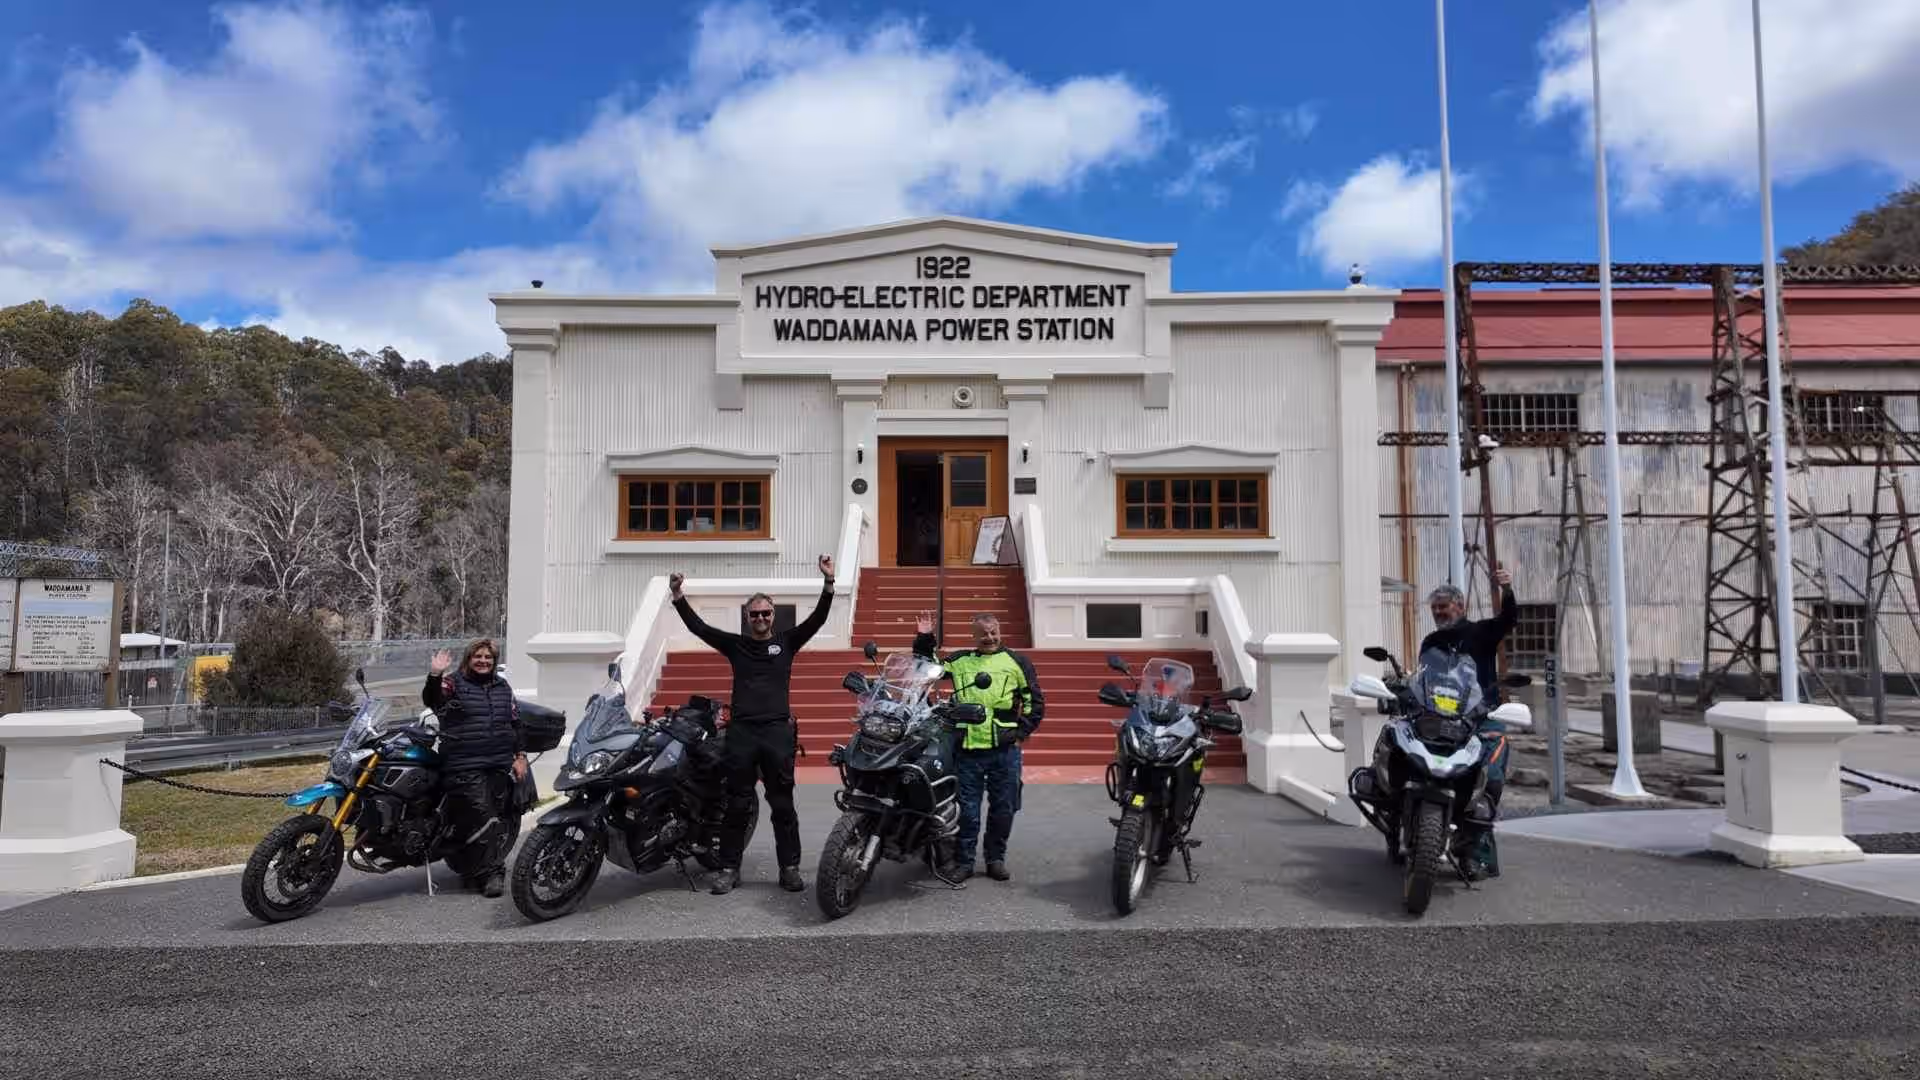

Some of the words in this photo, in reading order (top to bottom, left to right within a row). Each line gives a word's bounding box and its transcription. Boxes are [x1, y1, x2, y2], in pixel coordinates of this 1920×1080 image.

[916, 256, 971, 280] 1922
[756, 285, 965, 309] HYDRO-ELECTRIC
[973, 284, 1131, 308] DEPARTMENT
[774, 319, 918, 342] WADDAMANA
[926, 319, 1009, 341] POWER
[1017, 317, 1114, 341] STATION
[44, 584, 84, 592] WADDAMANA
